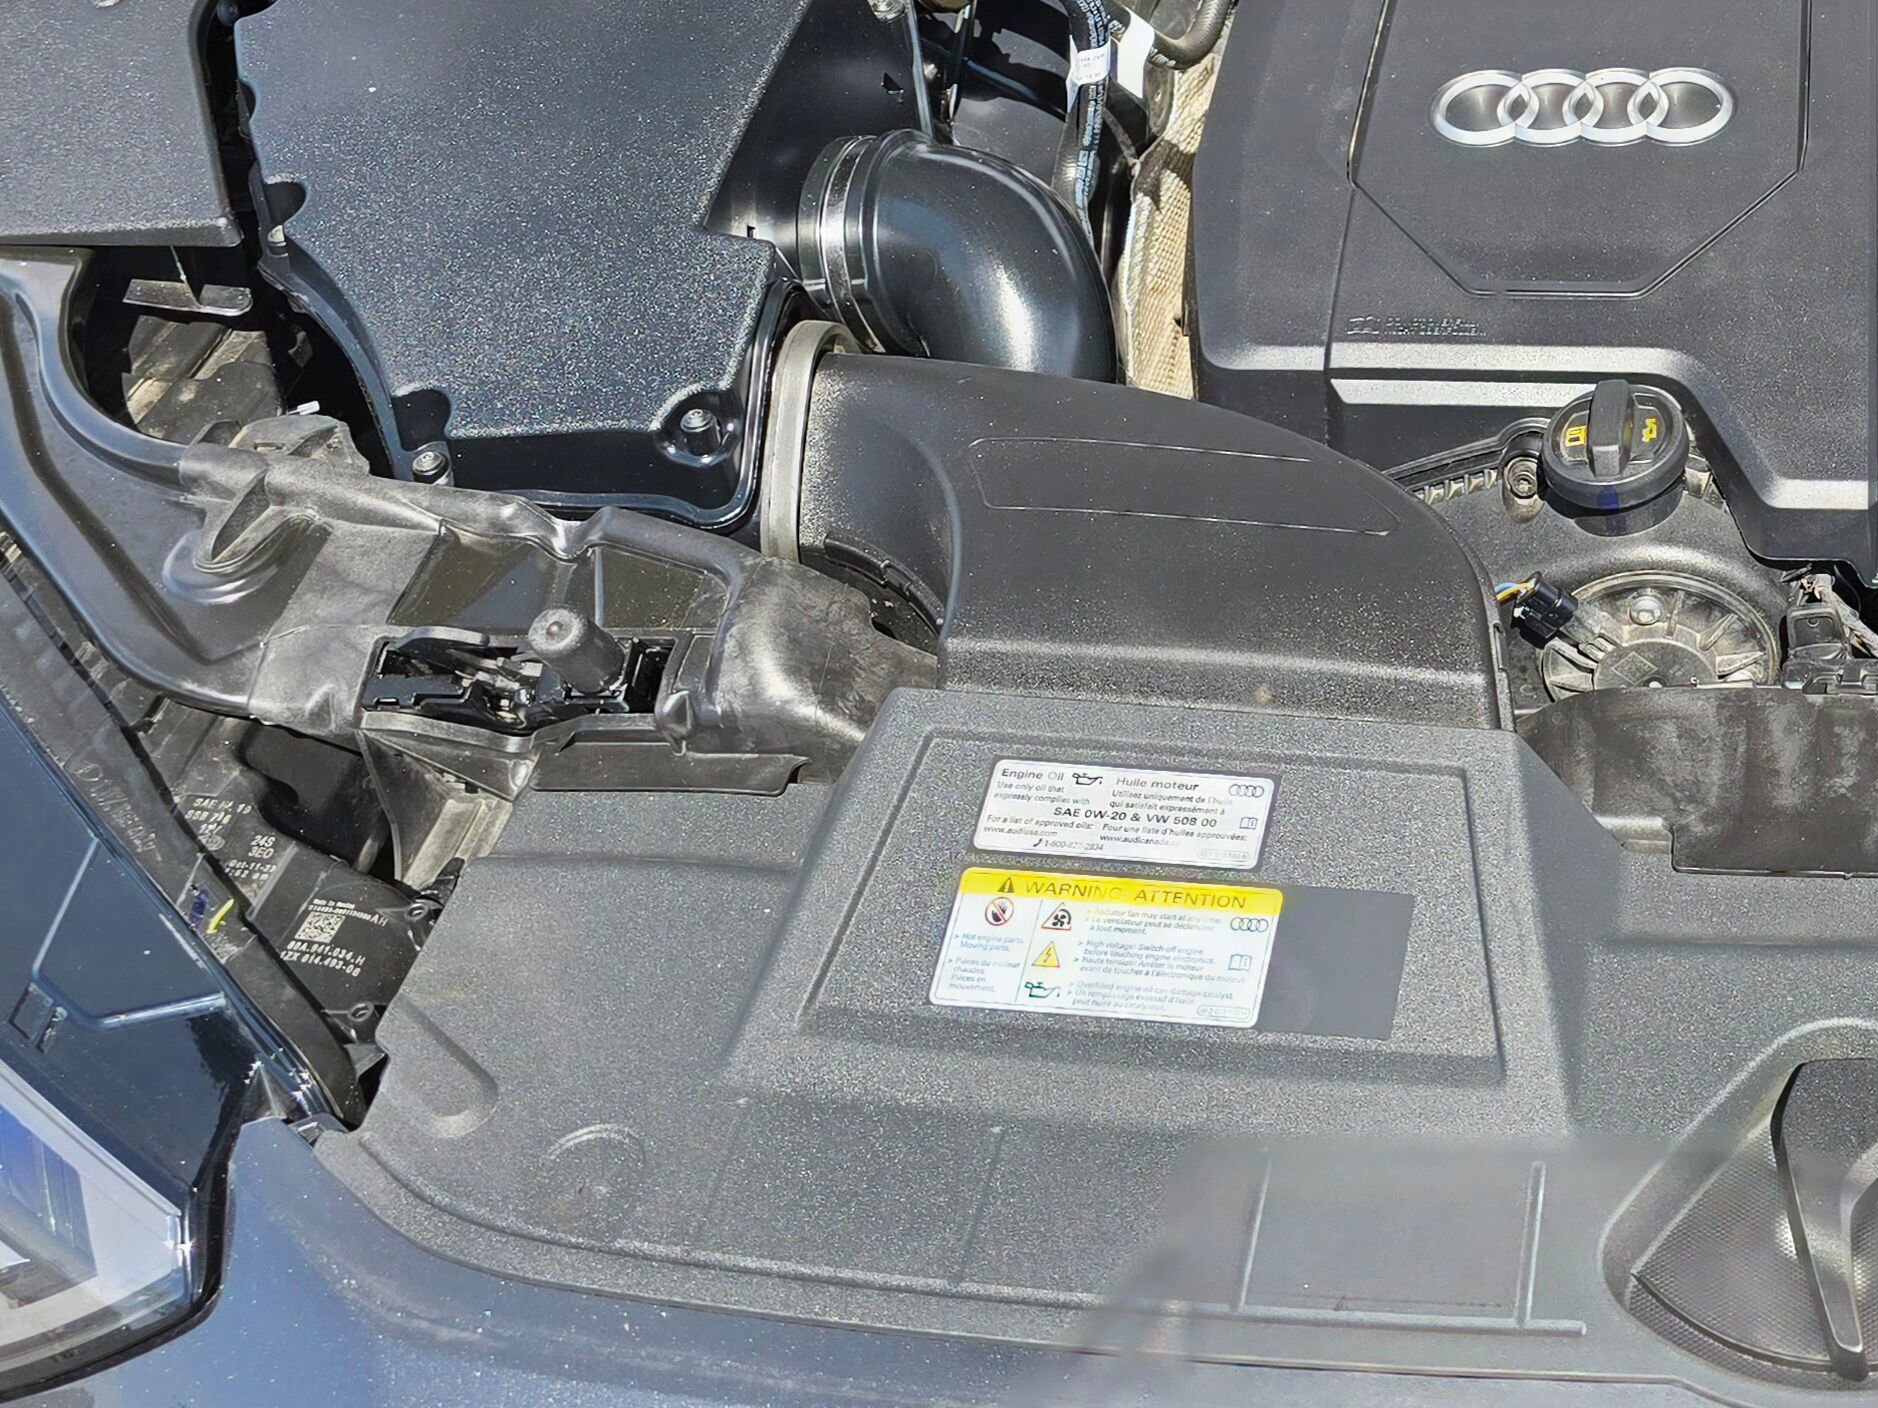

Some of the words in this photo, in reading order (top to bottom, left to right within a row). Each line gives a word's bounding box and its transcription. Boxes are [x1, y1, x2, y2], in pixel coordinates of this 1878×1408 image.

[1002, 768, 1043, 781] Engine
[1048, 771, 1064, 781] Oil
[997, 781, 1013, 789] Use
[1015, 783, 1034, 791] only
[1035, 784, 1046, 792] oil
[1048, 785, 1065, 793] that
[1116, 776, 1147, 788] Huile
[1151, 780, 1200, 791] moteur
[193, 798, 218, 808] SAE
[994, 792, 1031, 802] expressly
[1034, 795, 1070, 804] complies
[1073, 797, 1090, 805] with
[1144, 793, 1193, 804] uniquement
[184, 809, 209, 821] SSB
[1054, 807, 1081, 817] SAE
[1084, 809, 1126, 821] 0W-20
[1130, 813, 1141, 822] &
[1146, 814, 1170, 824] VW
[1173, 817, 1197, 826] 508
[1201, 818, 1217, 827] 00
[987, 815, 1001, 823] For
[1010, 816, 1022, 824] list
[1034, 819, 1074, 829] approved
[1102, 823, 1123, 832] Pour
[1124, 826, 1140, 834] une
[1142, 825, 1159, 834] liste
[250, 835, 276, 847] 24S
[1025, 880, 1122, 899] WARNING
[1134, 889, 1246, 909] ATTENTION
[1160, 913, 1177, 921] start
[962, 933, 976, 941] Hot
[1139, 944, 1164, 952] Switch
[280, 951, 300, 961] 1ZX
